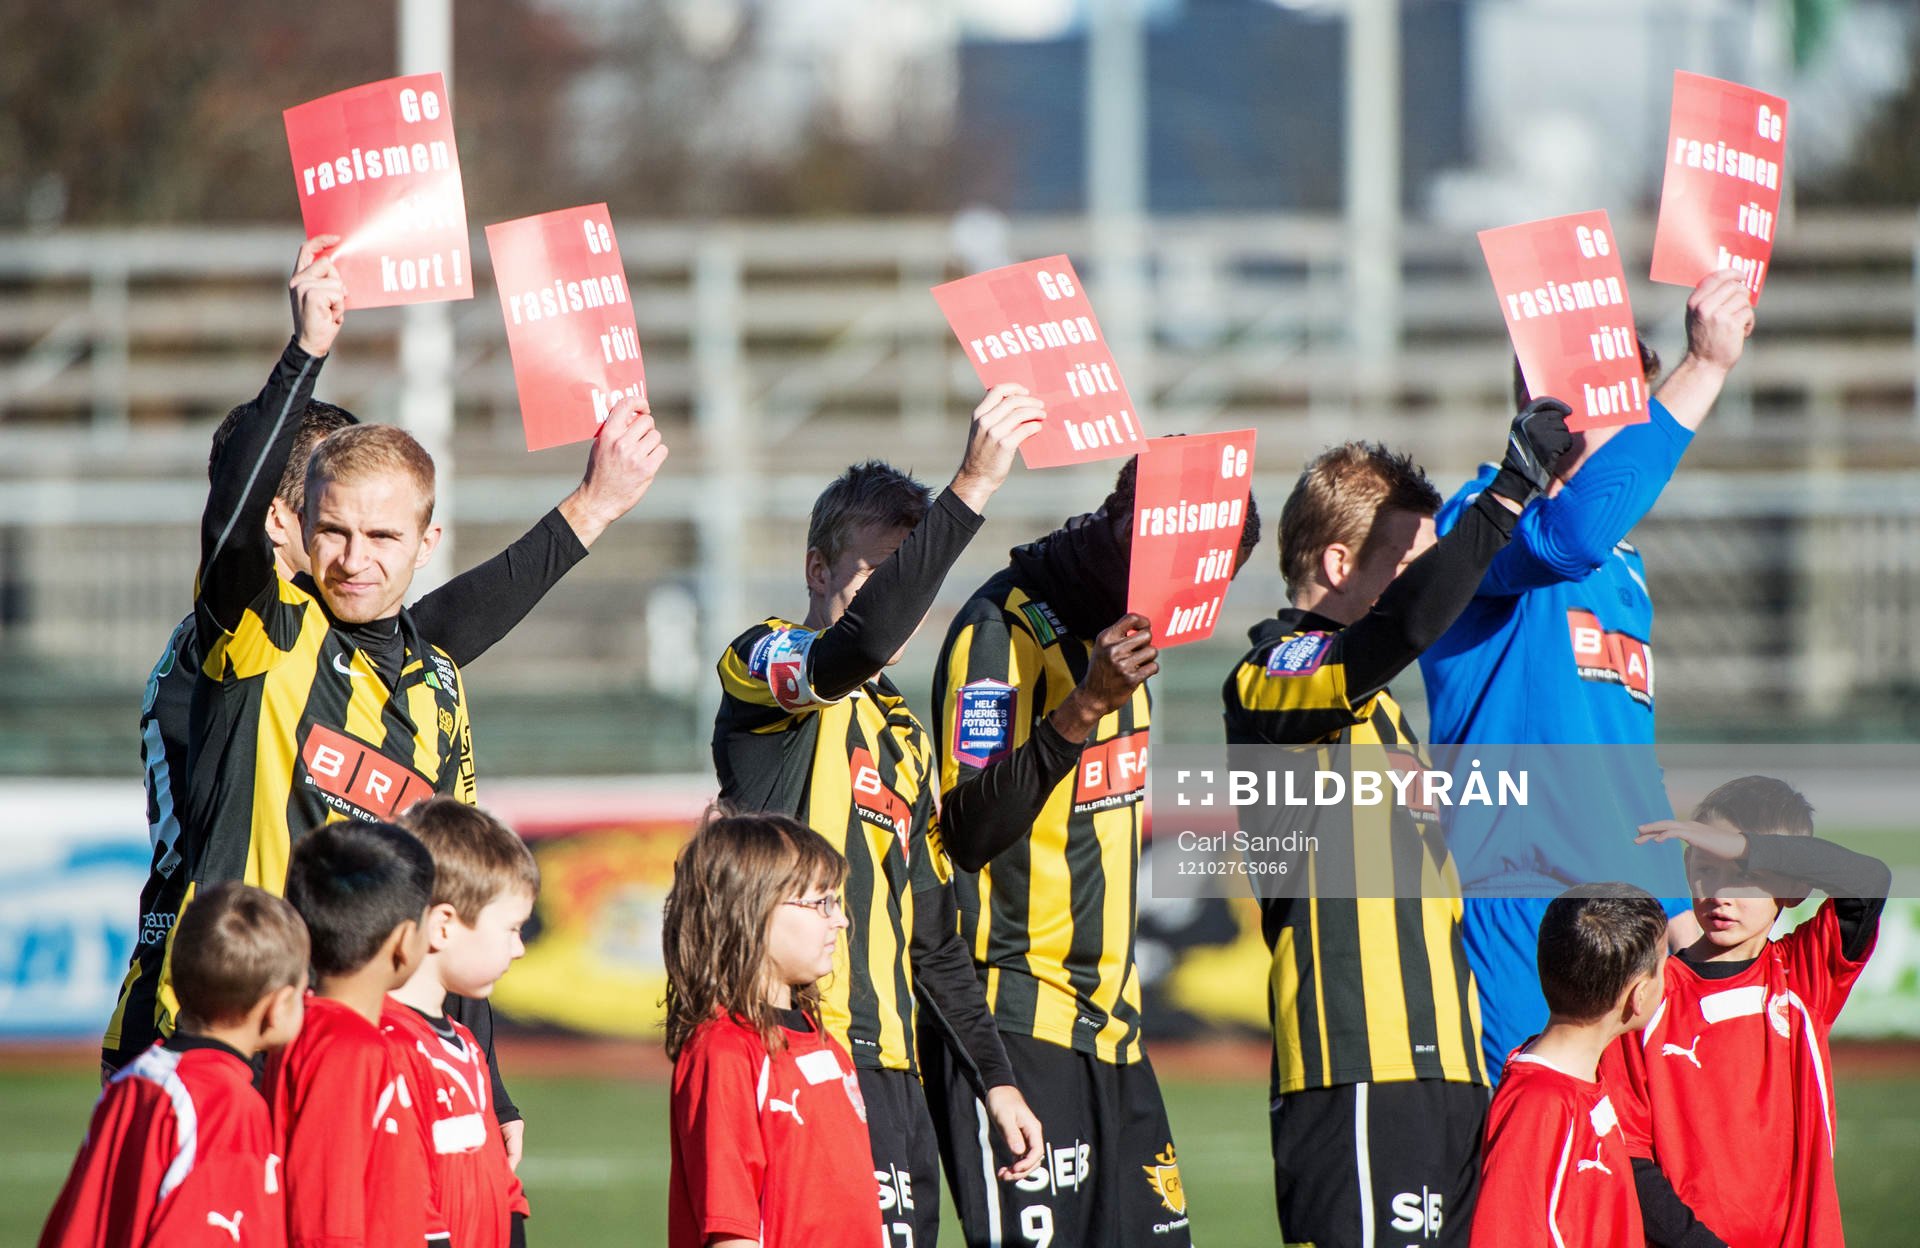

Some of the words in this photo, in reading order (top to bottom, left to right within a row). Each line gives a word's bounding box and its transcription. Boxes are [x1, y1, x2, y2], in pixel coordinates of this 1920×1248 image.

[400, 88, 440, 123] Ge
[1757, 104, 1783, 143] Ge
[303, 139, 450, 196] rasismen
[1674, 137, 1779, 190] rasismen
[583, 219, 612, 255] Ge
[1738, 202, 1774, 242] rött
[1575, 224, 1610, 259] Ge
[380, 252, 446, 293] kort
[1037, 270, 1076, 302] Ge
[509, 273, 627, 325] rasismen
[1506, 276, 1624, 321] rasismen
[600, 325, 639, 364] rött
[970, 315, 1098, 364] rasismen
[1589, 326, 1634, 362] rött
[1064, 362, 1119, 398] rött
[1583, 381, 1630, 417] kort
[1063, 412, 1124, 451] kort
[1220, 444, 1248, 480] Ge
[1138, 498, 1243, 537] rasismen
[1193, 549, 1234, 585] rött
[963, 709, 1008, 718] SVERIGES
[974, 699, 998, 709] HELA
[962, 718, 1008, 728] FOTBOLLS
[968, 727, 1000, 737] KLUBB
[1020, 1204, 1054, 1248] 9
